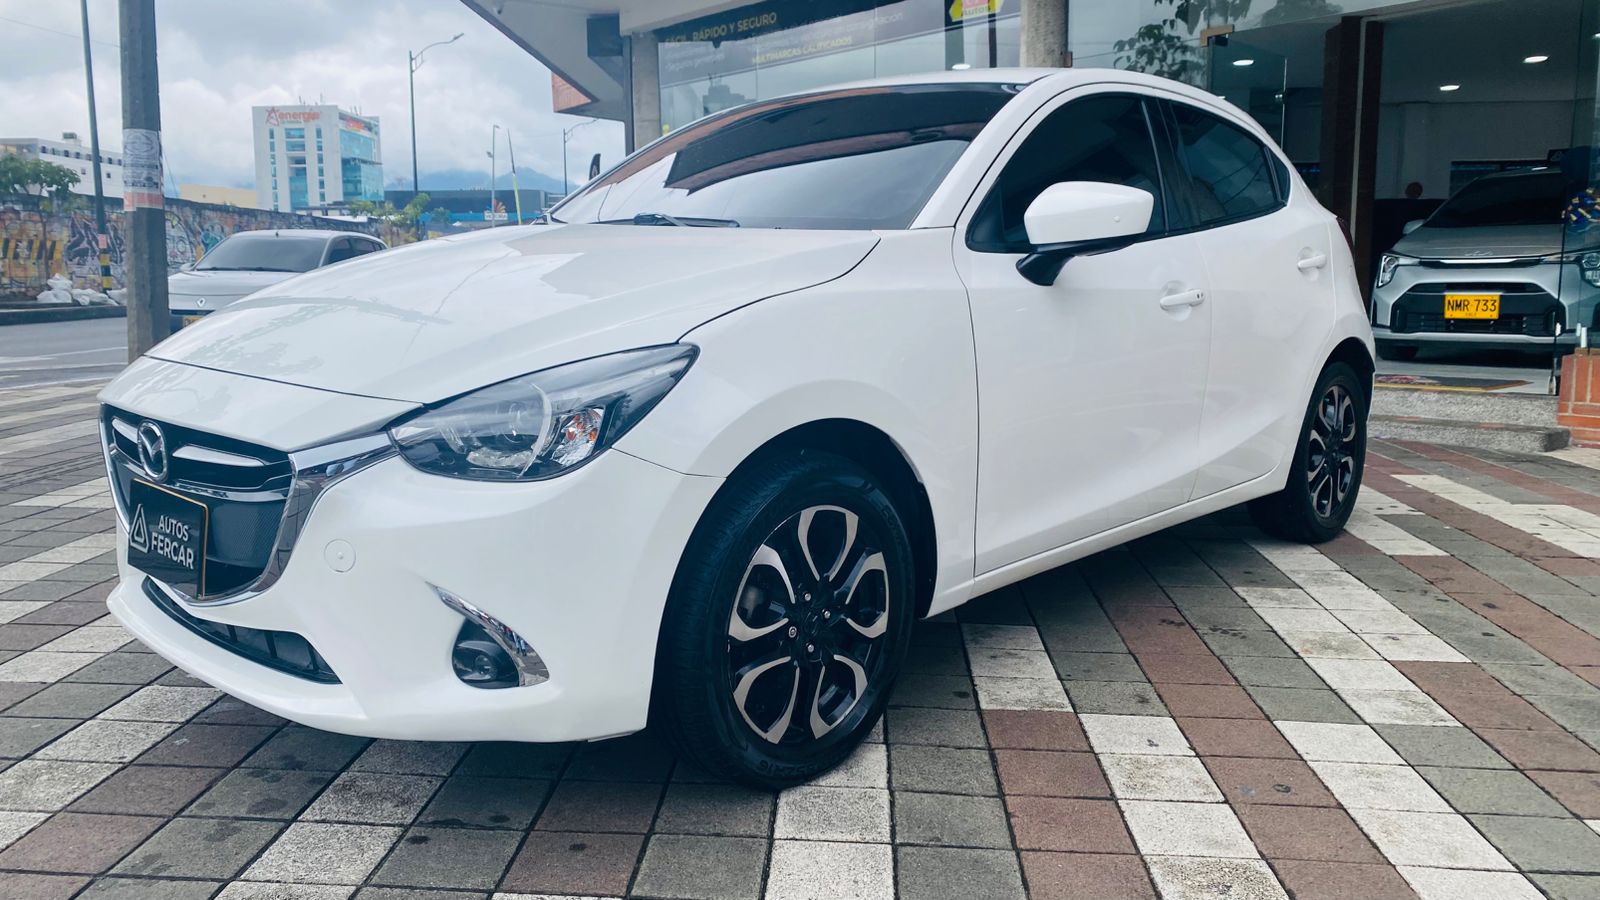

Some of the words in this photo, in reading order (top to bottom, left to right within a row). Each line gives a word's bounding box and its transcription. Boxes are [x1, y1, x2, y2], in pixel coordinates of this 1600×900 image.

[729, 22, 736, 33] Y
[737, 12, 777, 32] SEGURO
[1447, 299, 1470, 312] NMR
[1473, 299, 1497, 312] 733
[158, 515, 189, 541] AUTOS
[151, 532, 194, 569] FERCAR
